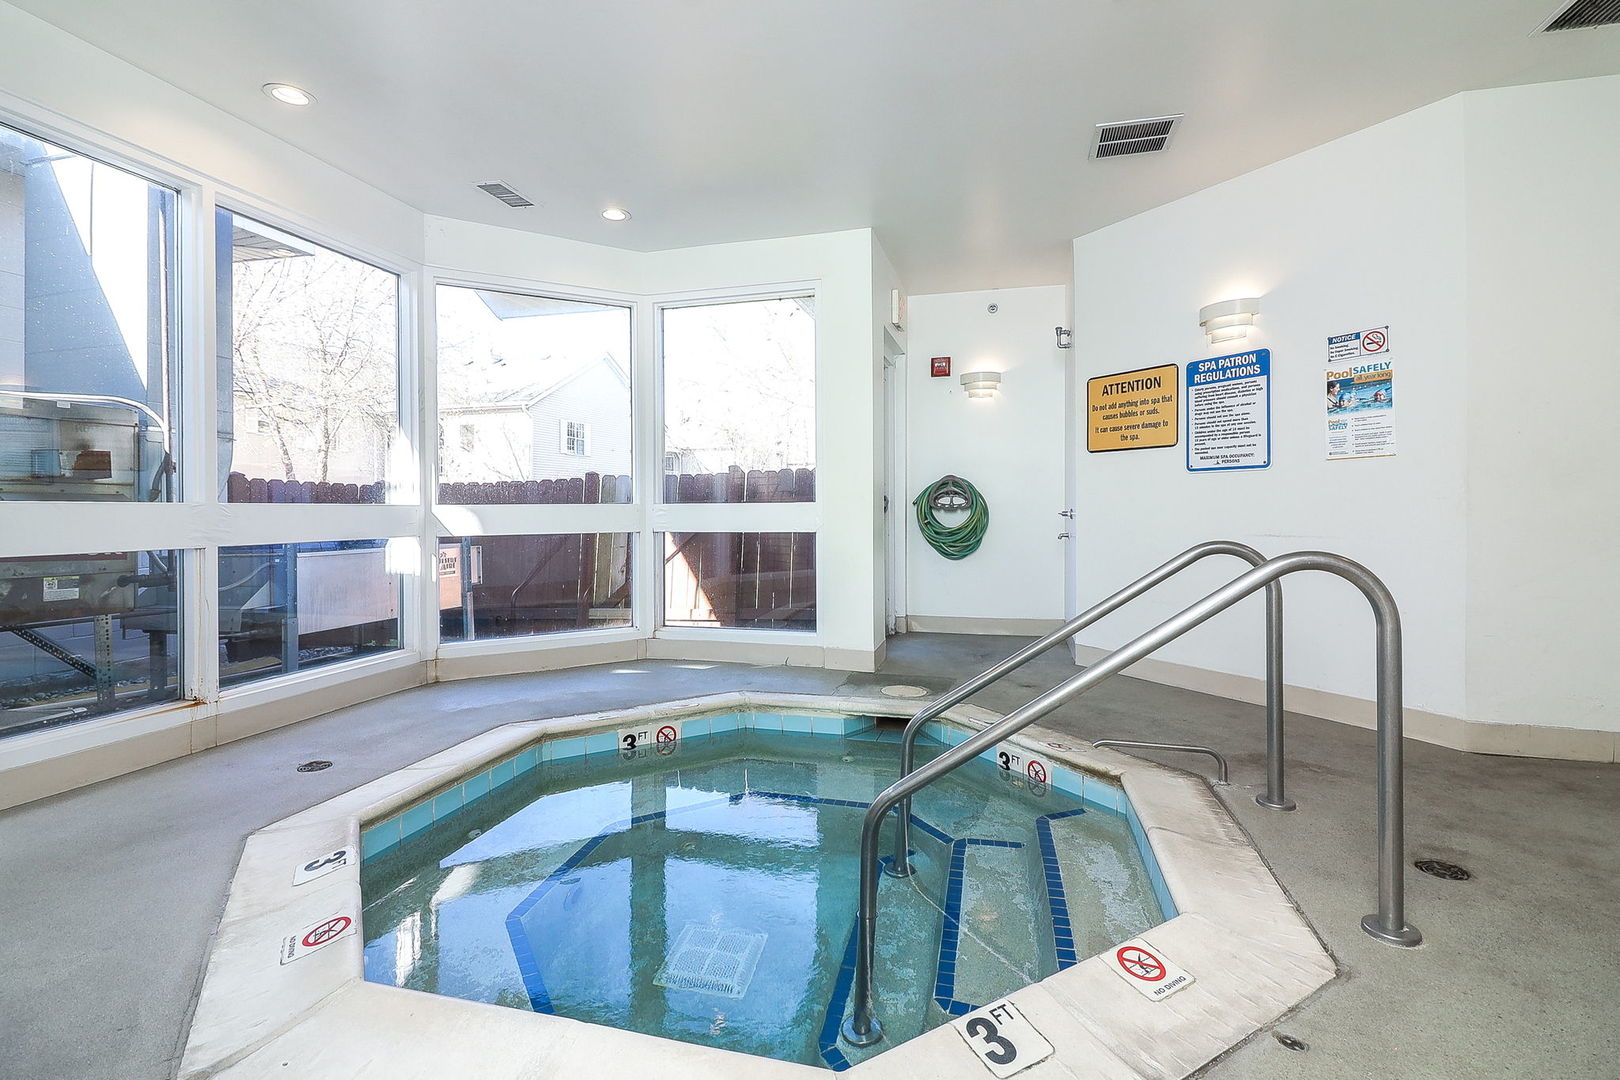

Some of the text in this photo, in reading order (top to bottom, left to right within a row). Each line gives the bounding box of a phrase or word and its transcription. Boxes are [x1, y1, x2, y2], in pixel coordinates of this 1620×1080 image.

[1332, 334, 1356, 343] NOTICE
[1199, 353, 1256, 372] SPA PATRON
[1327, 361, 1391, 380] Pool SAFELY
[1194, 364, 1260, 383] REGULATIONS
[1102, 376, 1161, 396] ATTENTION
[1118, 400, 1138, 409] anything
[1161, 394, 1172, 402] that
[1120, 410, 1138, 418] bubbles
[1141, 421, 1161, 429] damage
[622, 731, 648, 750] 3 FT
[999, 752, 1020, 770] 3 FT
[304, 851, 346, 872] 3
[1154, 976, 1186, 996] NO DIVING
[966, 1003, 1017, 1065] 3 FT
